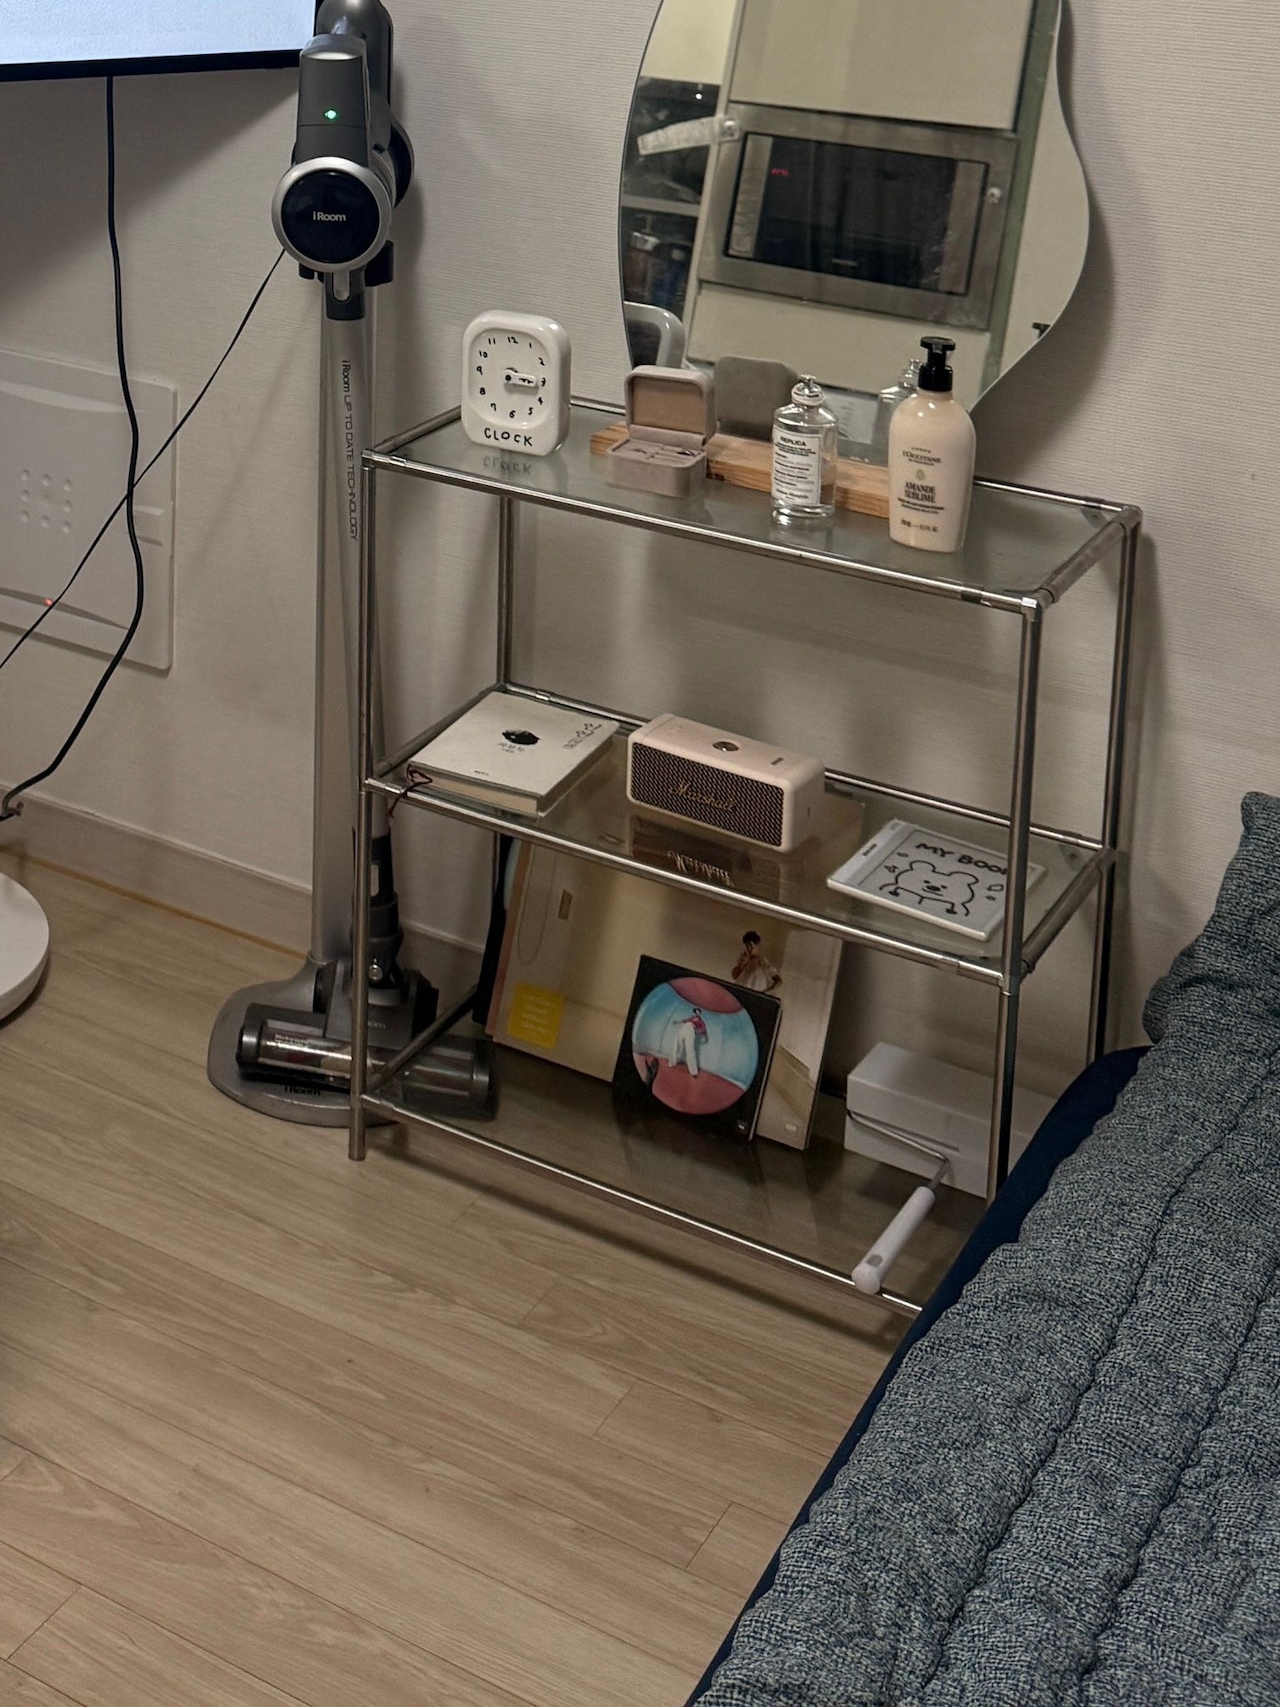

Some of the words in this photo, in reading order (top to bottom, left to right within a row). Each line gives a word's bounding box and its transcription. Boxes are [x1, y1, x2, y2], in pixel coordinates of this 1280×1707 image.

[488, 337, 496, 345] 11
[507, 336, 519, 344] 12
[479, 350, 488, 359] 10
[538, 357, 546, 367] 2
[476, 365, 483, 376] 9
[541, 377, 547, 387] 3
[479, 387, 486, 396] 8
[537, 396, 544, 406] 4
[490, 402, 497, 412] 7
[528, 406, 535, 416] 5
[509, 410, 517, 419] 6
[345, 414, 353, 430] TO
[484, 427, 533, 447] CLOCK
[346, 432, 354, 462] DATE
[347, 464, 358, 542] TECHNOLOGY
[916, 843, 954, 858] MY
